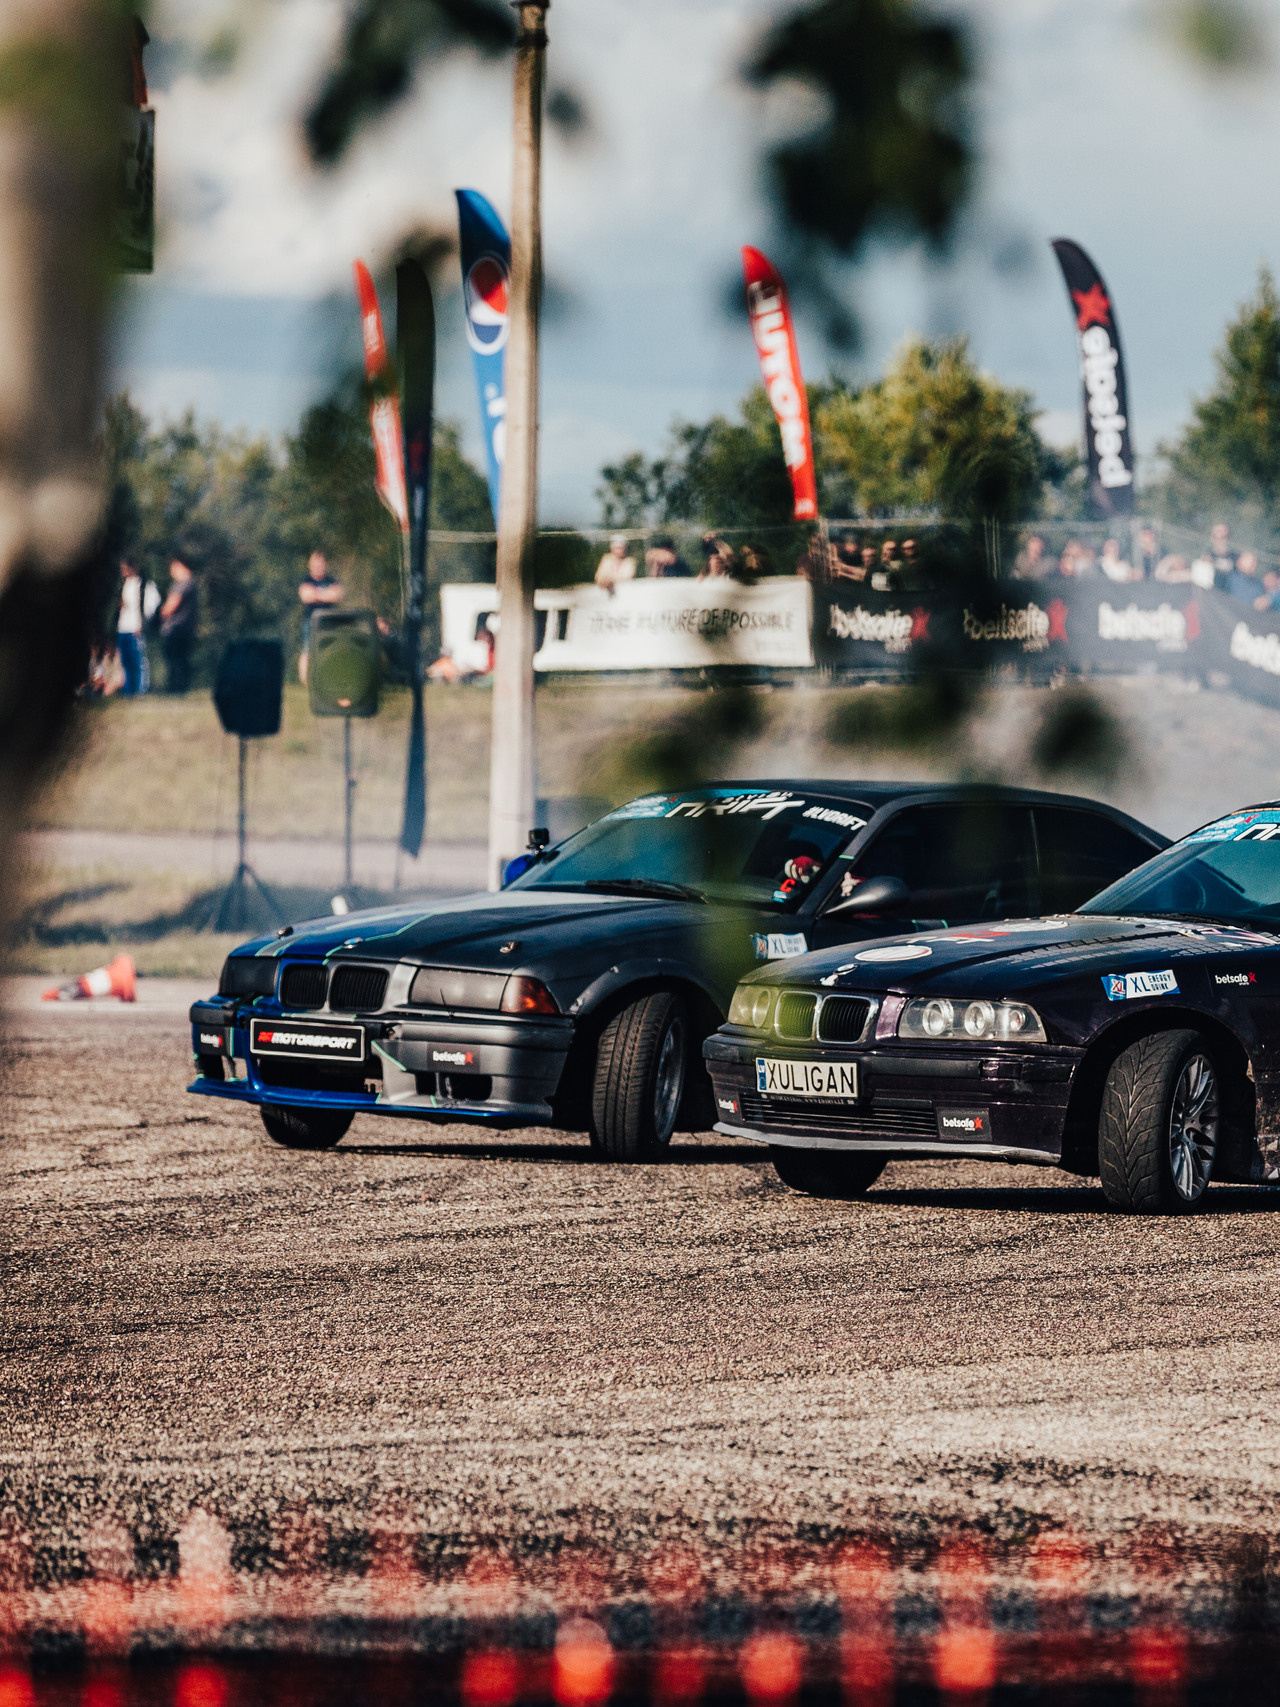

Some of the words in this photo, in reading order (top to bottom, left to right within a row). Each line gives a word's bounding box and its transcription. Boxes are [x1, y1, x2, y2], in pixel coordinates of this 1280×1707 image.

[1130, 976, 1151, 993] XL
[1215, 974, 1248, 984] betsafe
[767, 1062, 855, 1093] XULIGAN
[943, 1117, 975, 1128] betsafe
